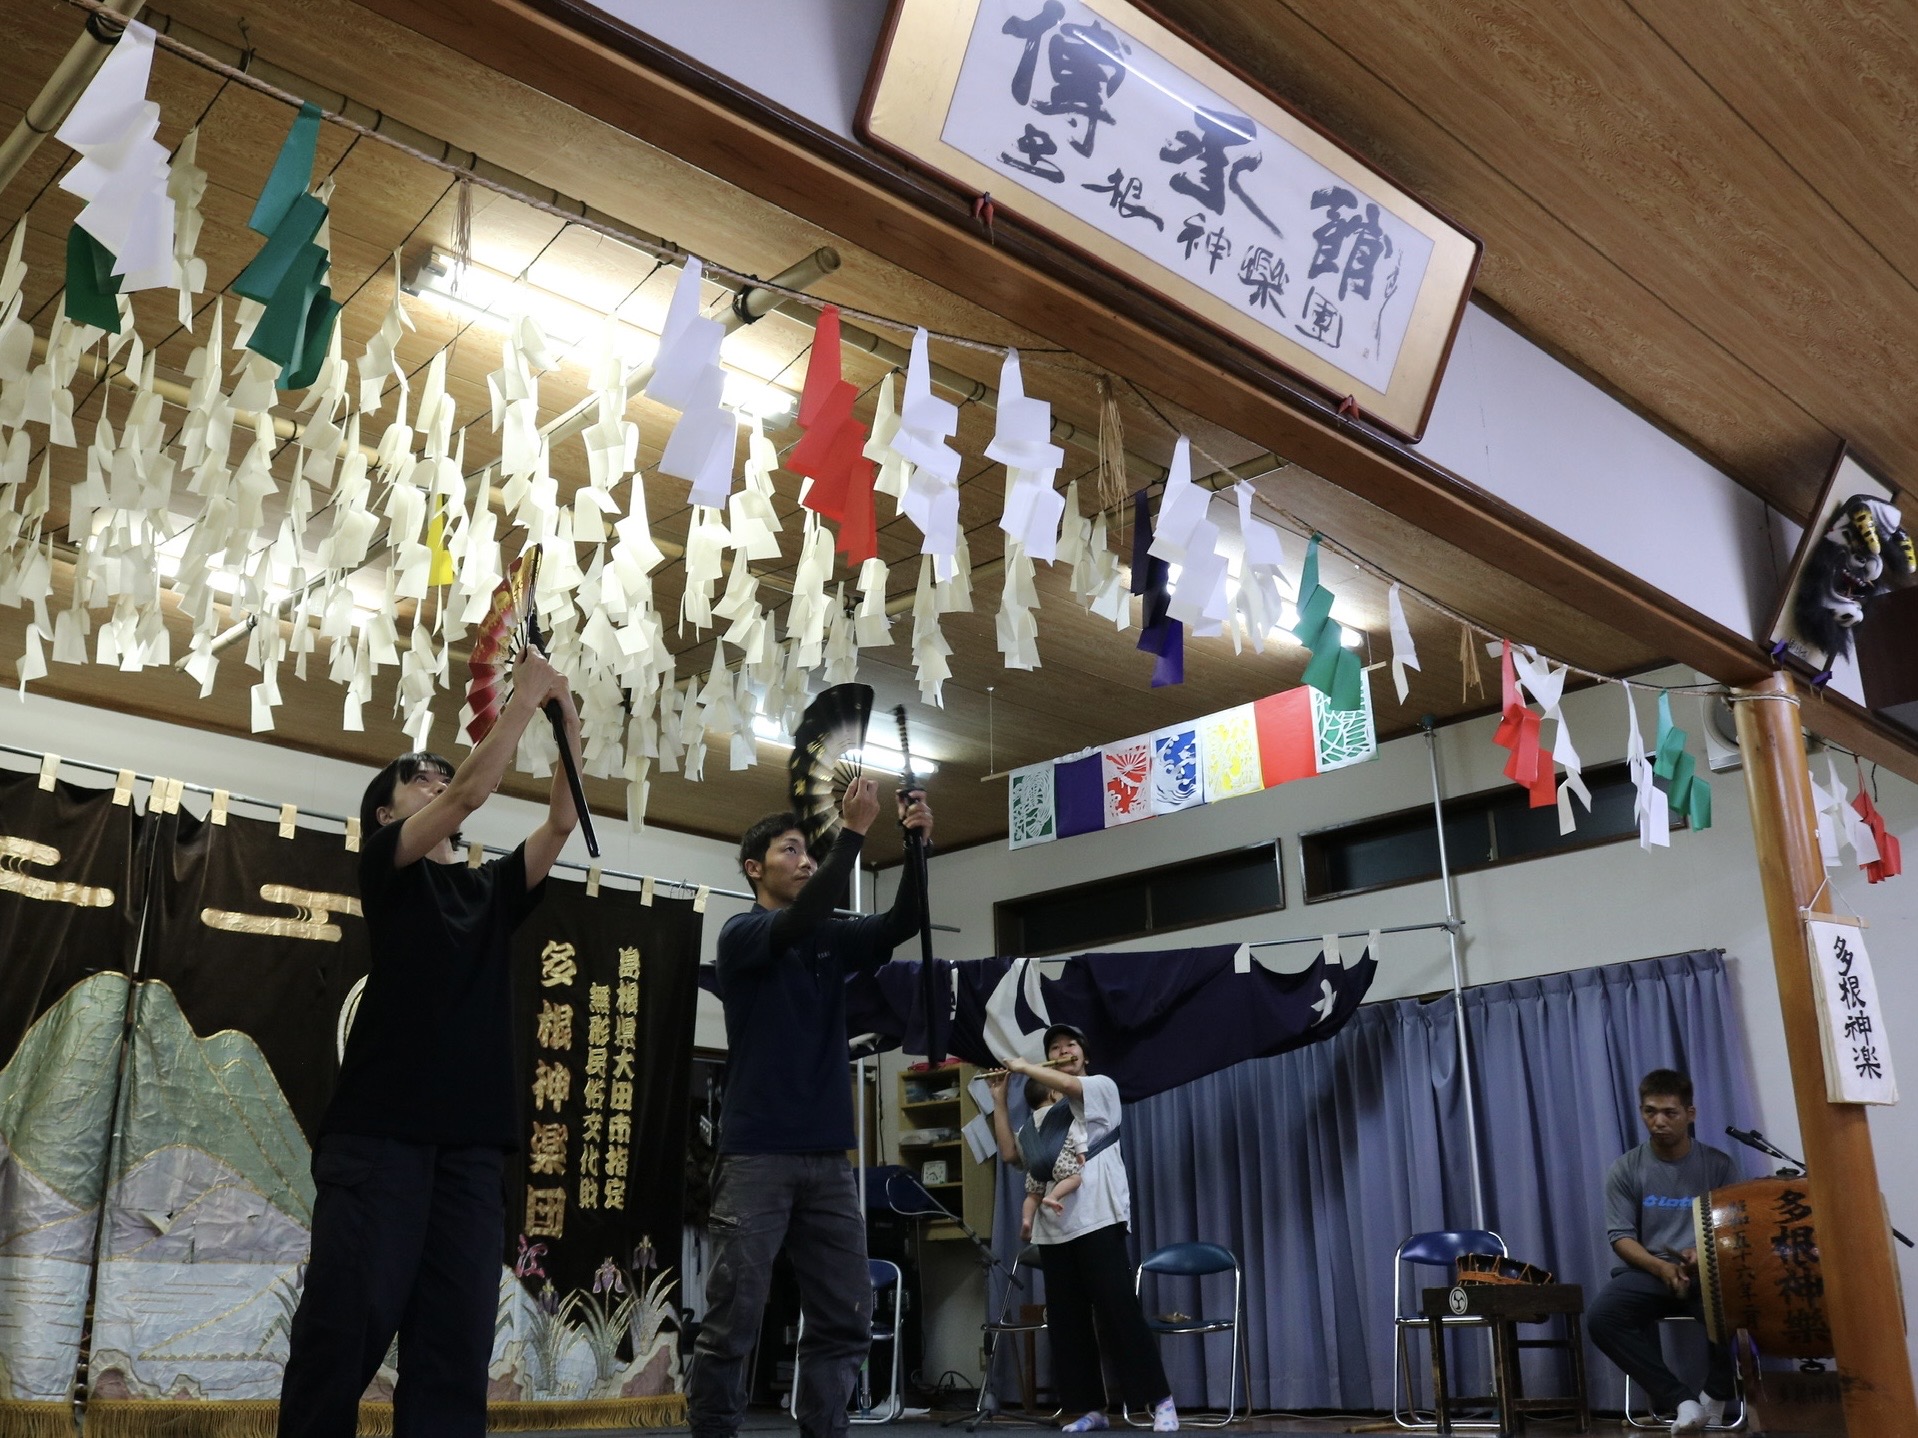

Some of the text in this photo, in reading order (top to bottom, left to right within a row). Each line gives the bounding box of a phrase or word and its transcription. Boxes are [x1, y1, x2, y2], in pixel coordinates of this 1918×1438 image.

[579, 982, 610, 1210] 無形民俗文化財
[1834, 935, 1882, 1079] 多根神楽
